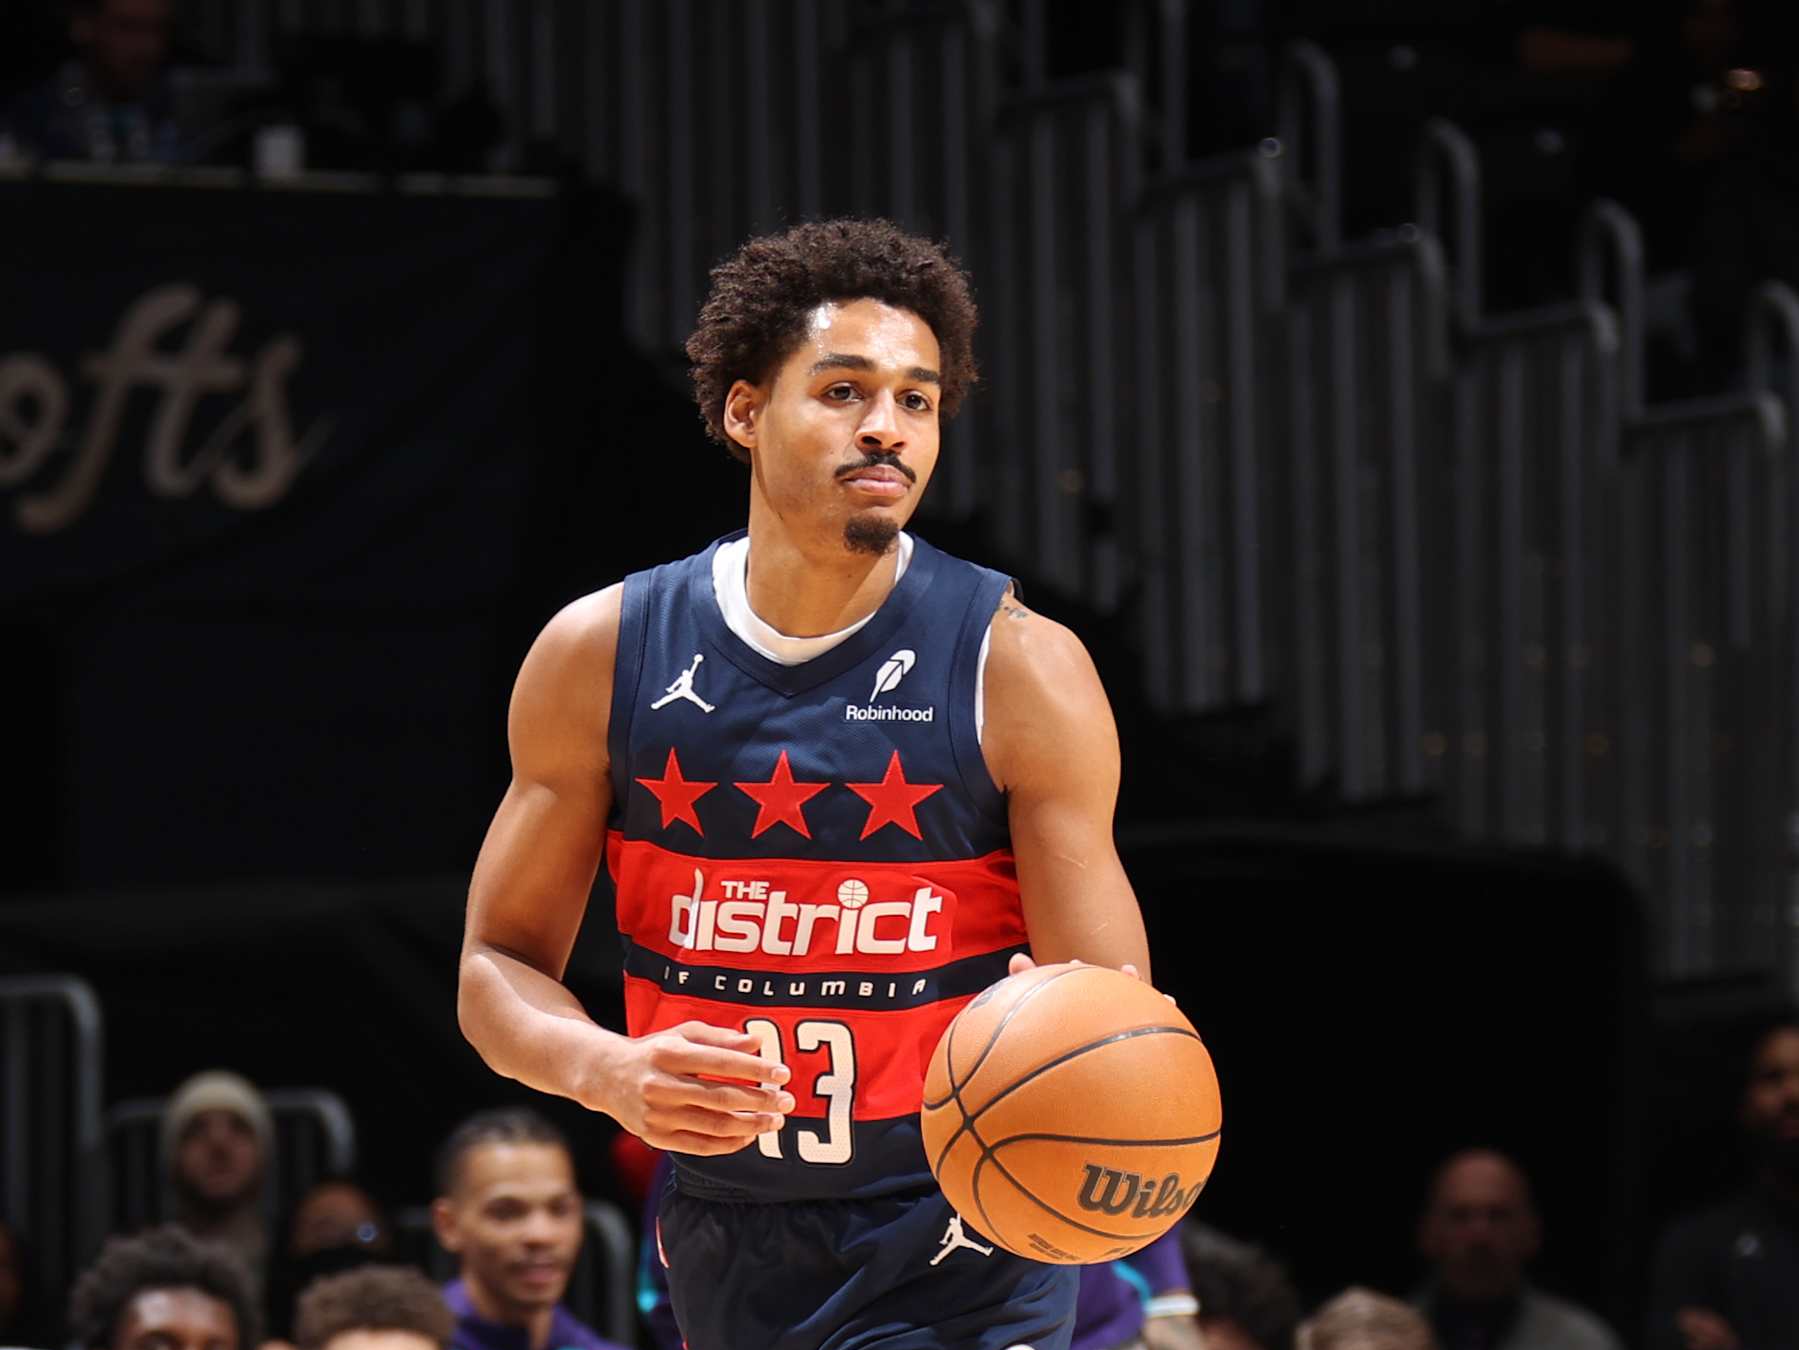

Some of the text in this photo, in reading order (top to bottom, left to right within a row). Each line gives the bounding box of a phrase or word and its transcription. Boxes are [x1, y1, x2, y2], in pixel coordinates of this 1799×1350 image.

[845, 704, 934, 722] Robinhood
[721, 880, 770, 900] THE
[668, 868, 943, 956] district
[714, 975, 927, 998] COLUMBIA
